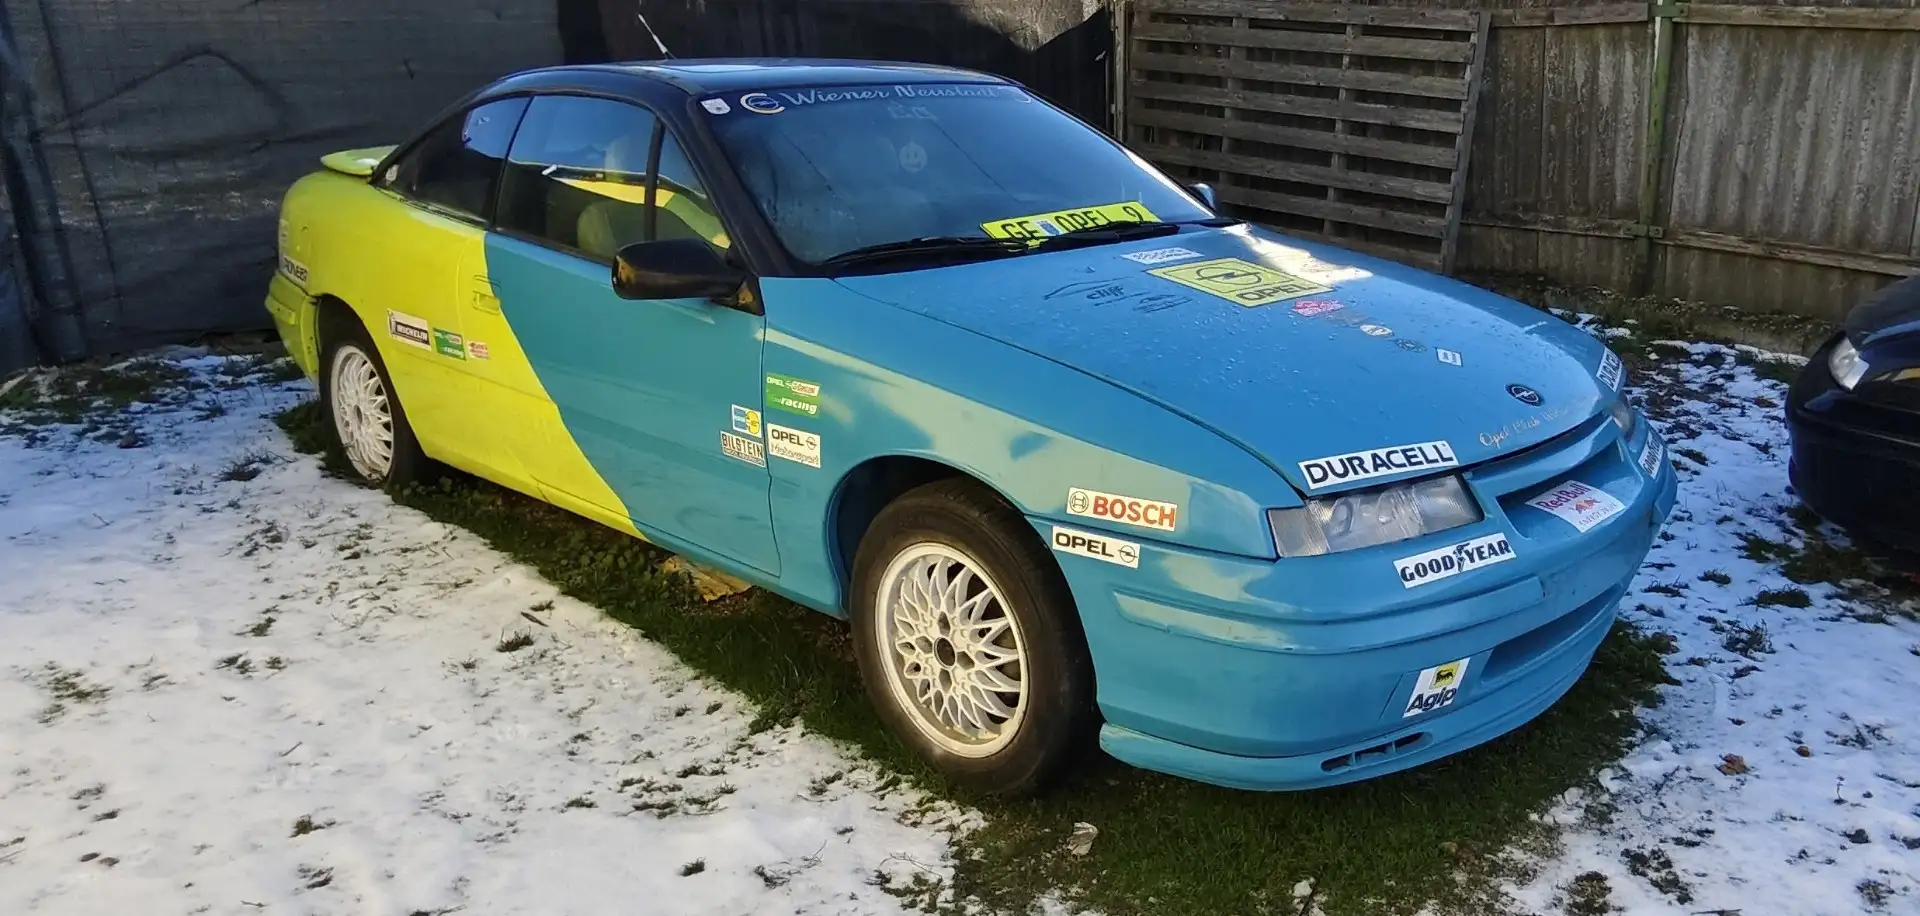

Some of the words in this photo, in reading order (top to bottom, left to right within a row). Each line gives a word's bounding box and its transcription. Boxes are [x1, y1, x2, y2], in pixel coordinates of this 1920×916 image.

[778, 88, 889, 105] Wiener
[1236, 281, 1318, 301] OPEL
[767, 377, 785, 387] OPEL
[780, 396, 818, 415] racing
[721, 434, 763, 459] BILSTEIN
[771, 429, 804, 447] OPEL
[1304, 444, 1454, 484] DURACELL
[1093, 495, 1175, 528] BOSCH
[1055, 532, 1114, 558] OPEL
[1406, 687, 1457, 712] Agip
